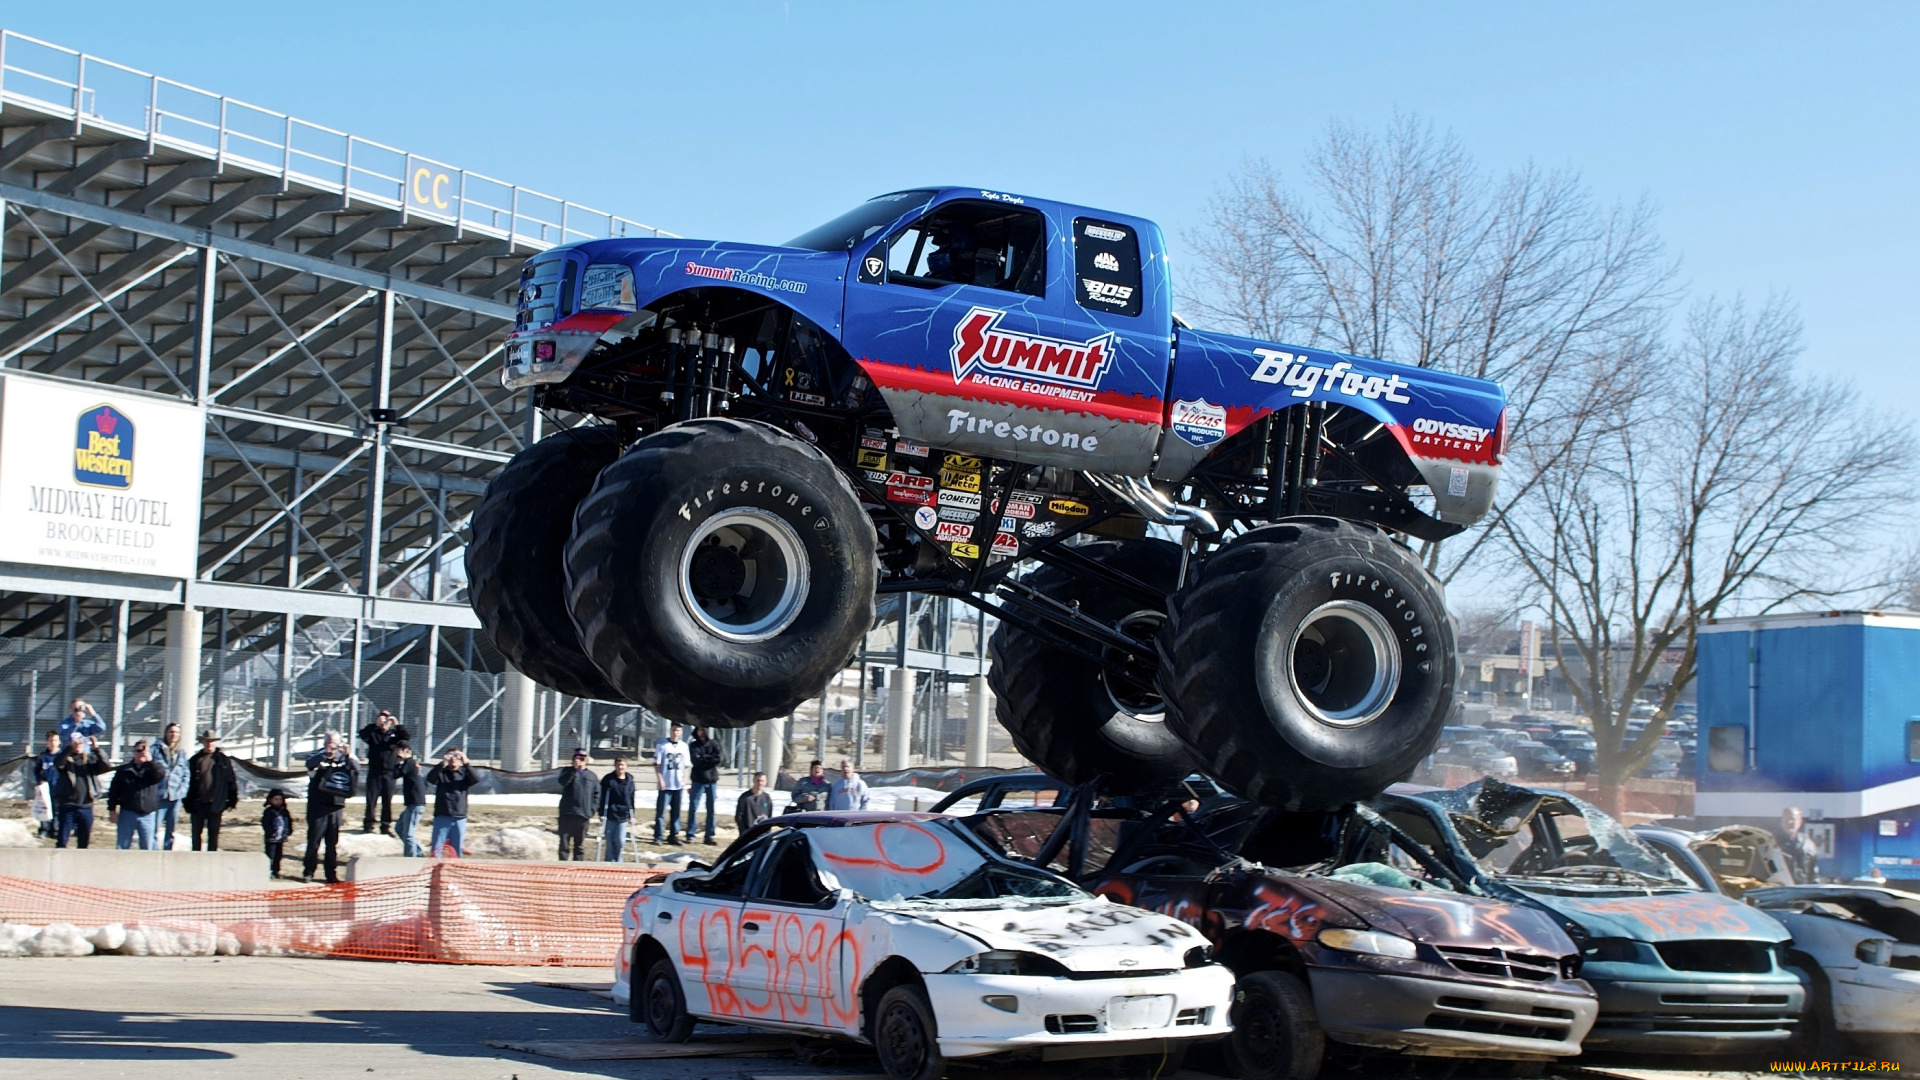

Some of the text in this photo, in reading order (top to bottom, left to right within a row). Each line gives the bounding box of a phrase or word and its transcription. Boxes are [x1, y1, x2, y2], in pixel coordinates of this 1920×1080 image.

[413, 168, 449, 210] CC
[981, 190, 1000, 200] Kyle
[685, 261, 807, 294] SummitRacing.com
[1251, 348, 1411, 404] Bigfoot
[971, 373, 1096, 403] RACING EQUIPMENT
[947, 409, 1099, 451] Firestone
[1180, 413, 1222, 427] LUCAS
[1413, 418, 1490, 443] ODYSSEY
[1187, 427, 1223, 437] PRODUCTS
[1191, 435, 1204, 443] INC.
[88, 430, 121, 456] Best
[1413, 435, 1482, 452] BATTERY
[75, 448, 132, 478] Western
[888, 473, 933, 488] ARP
[950, 479, 978, 489] Meter
[953, 473, 975, 482] Auto
[28, 485, 172, 527] MIDWAY HOTEL
[678, 480, 812, 521] Firestone
[940, 492, 980, 505] COMETIC
[1051, 502, 1087, 514] Milodon
[939, 523, 970, 537] MSD
[1002, 519, 1014, 529] K1
[46, 521, 155, 549] BROOKFIELD
[1330, 572, 1428, 653] Firestone
